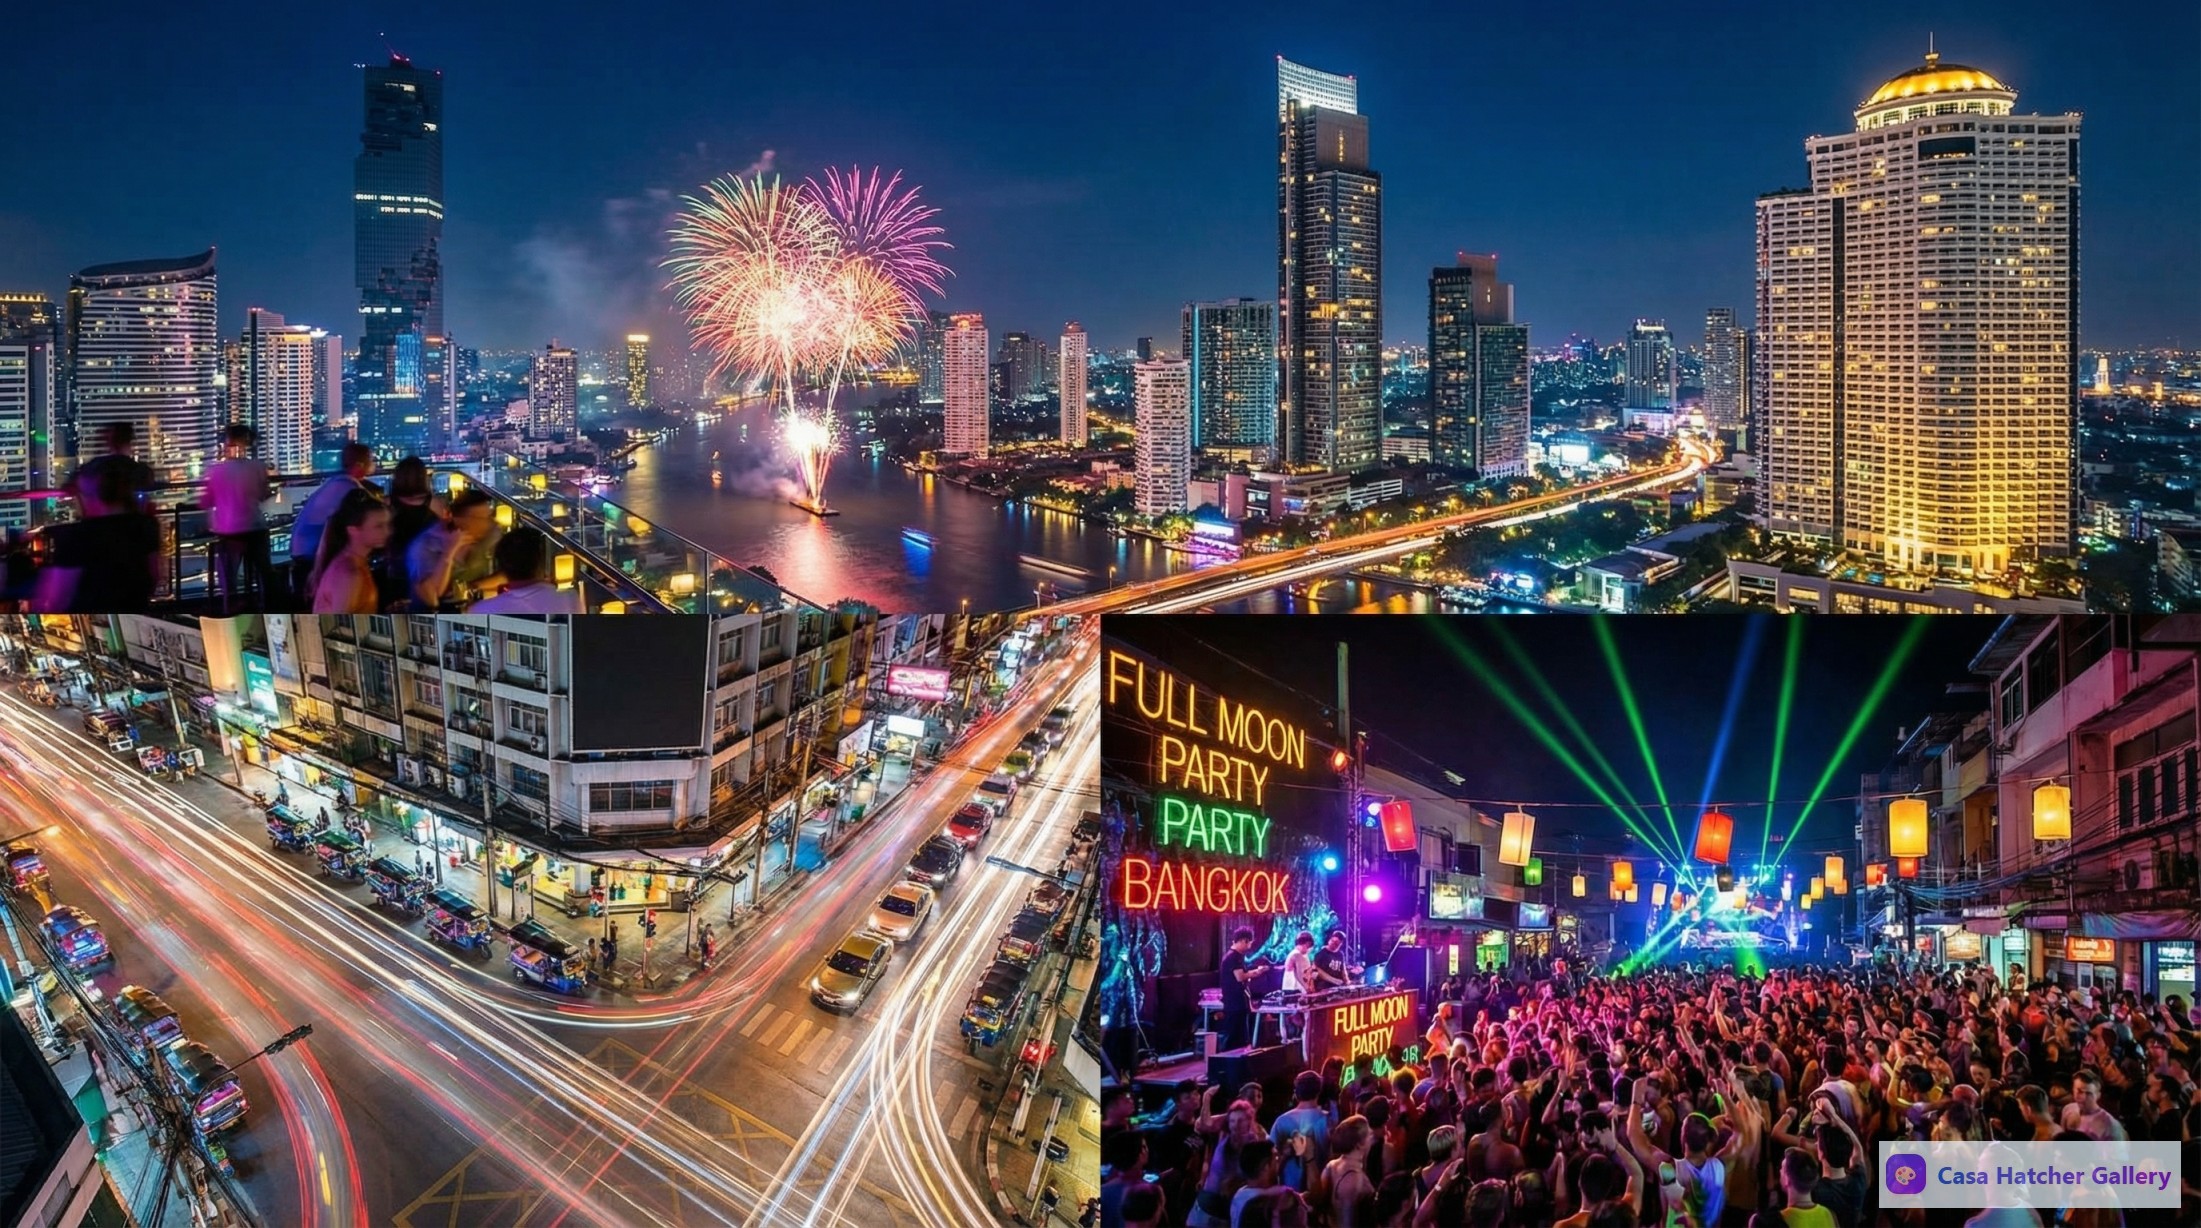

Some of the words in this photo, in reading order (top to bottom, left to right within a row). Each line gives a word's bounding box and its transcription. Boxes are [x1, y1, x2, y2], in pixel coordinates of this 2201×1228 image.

[1109, 649, 1208, 736] FULL
[1218, 695, 1305, 770] MOON
[1161, 734, 1269, 806] PARTY
[1163, 797, 1271, 858] PARTY
[1125, 858, 1290, 914] BANGKOK
[1334, 1003, 1369, 1036] FULL
[1370, 994, 1409, 1027] MOON
[1351, 1025, 1394, 1063] PARTY
